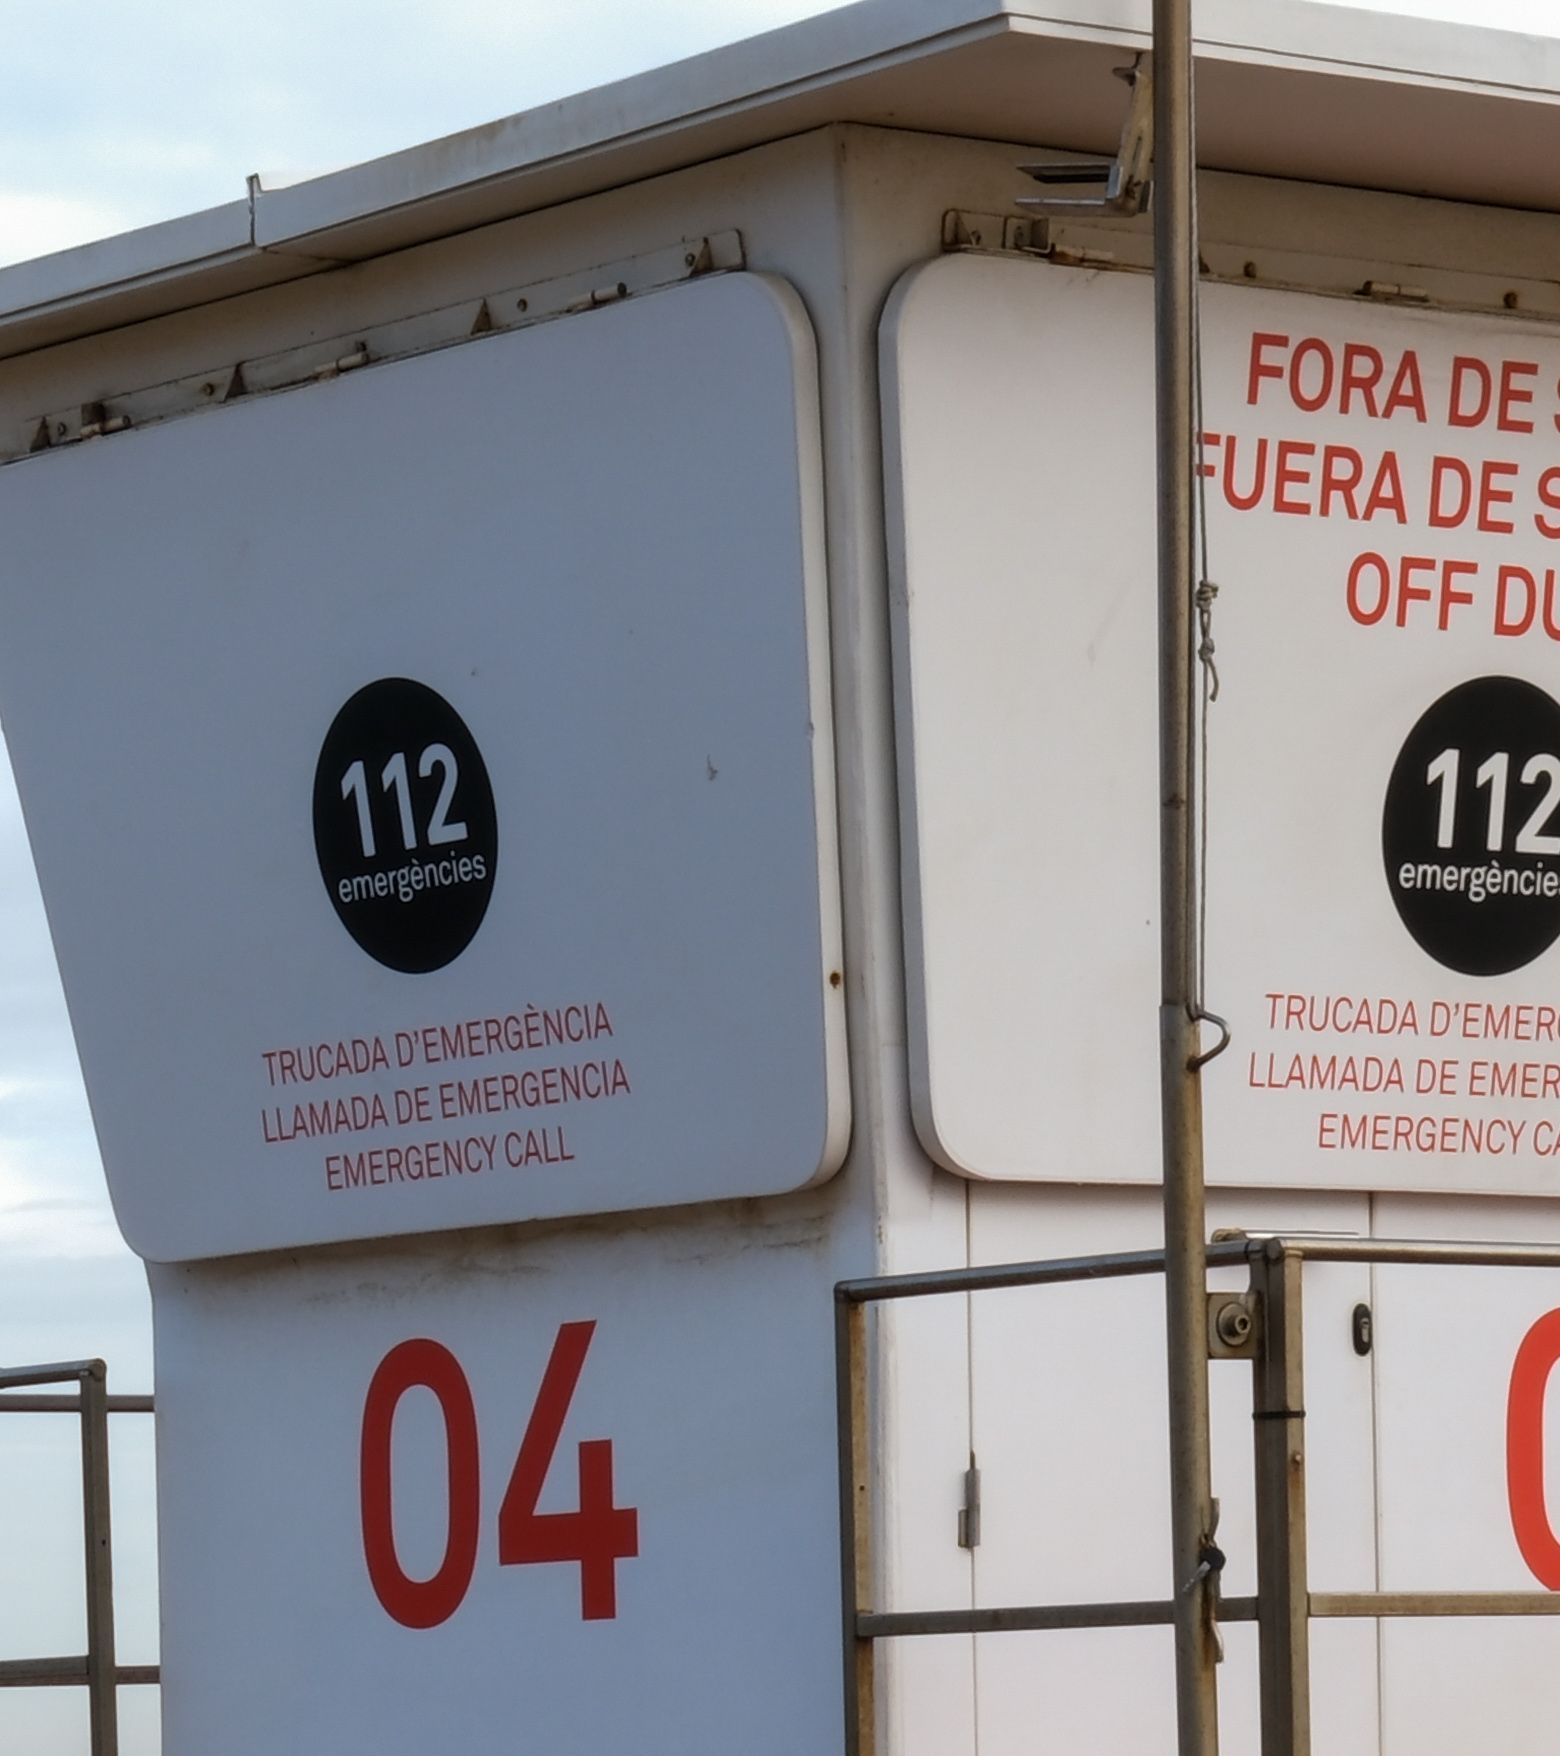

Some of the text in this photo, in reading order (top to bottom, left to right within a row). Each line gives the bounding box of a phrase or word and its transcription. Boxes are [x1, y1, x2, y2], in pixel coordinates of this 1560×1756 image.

[1246, 331, 1428, 423] FORA
[1447, 356, 1539, 437] DE
[1427, 456, 1520, 535] DE
[1346, 551, 1479, 633] OFF
[340, 743, 469, 858] 112
[338, 850, 487, 903] emergències
[1266, 993, 1419, 1038] TRUCADA
[262, 1036, 389, 1085] TRUCADA
[1248, 1051, 1406, 1095] LLAMADA
[1416, 1058, 1457, 1097] DE
[261, 1058, 631, 1143] LLAMADA DE EMERGENCIA
[1317, 1112, 1525, 1156] EMERGENCY
[326, 1126, 575, 1191] EMERGENCY CALL
[360, 1319, 639, 1630] 04
